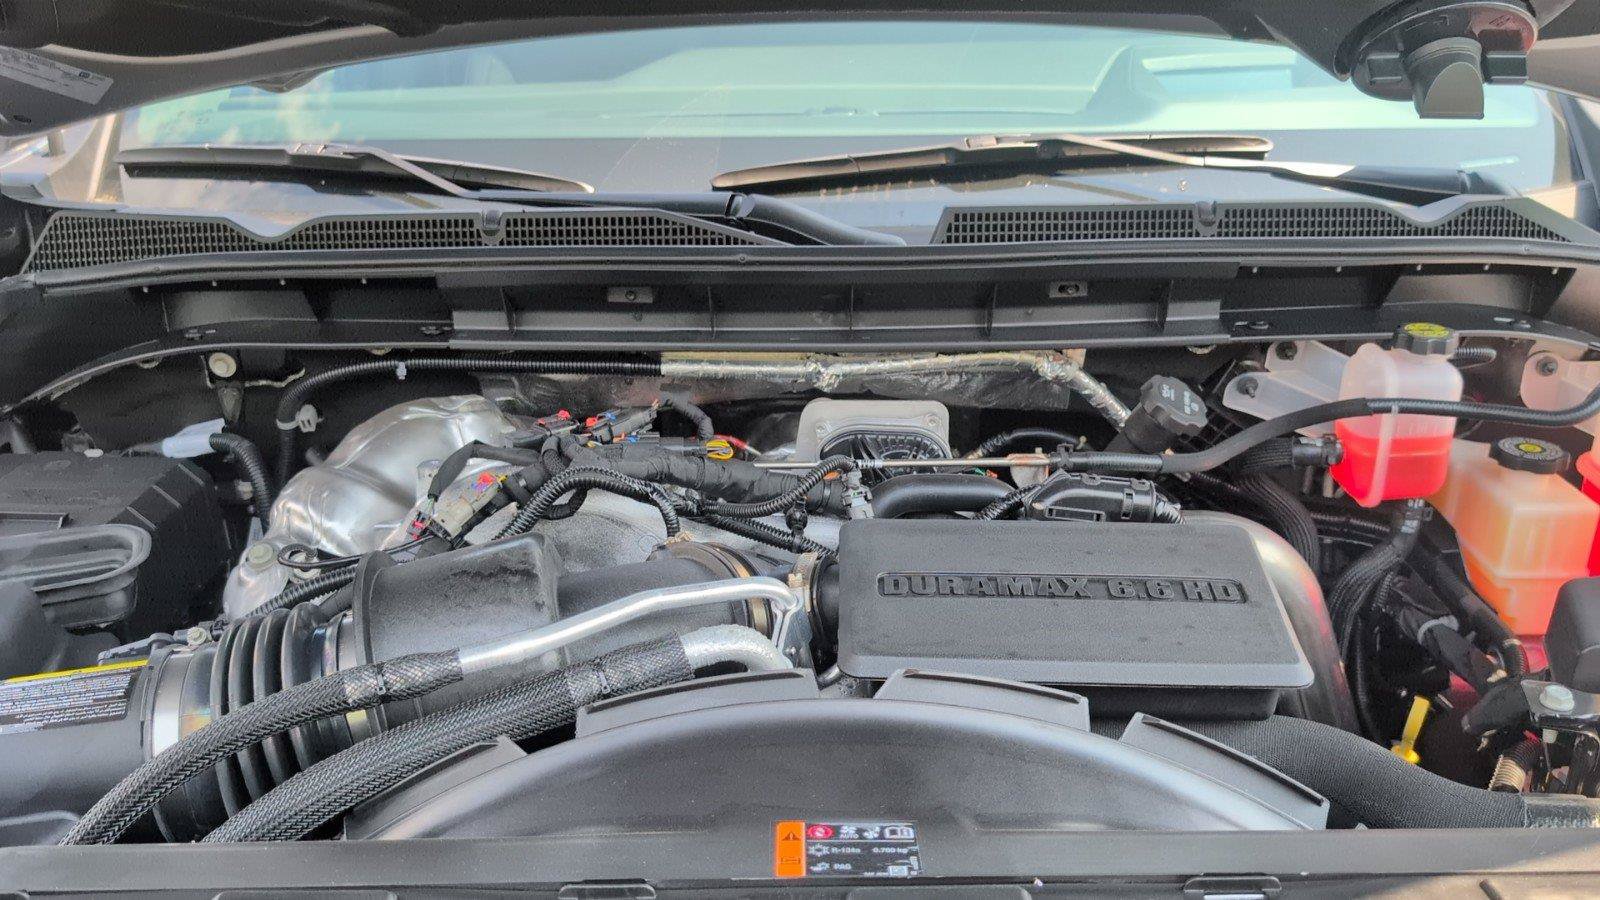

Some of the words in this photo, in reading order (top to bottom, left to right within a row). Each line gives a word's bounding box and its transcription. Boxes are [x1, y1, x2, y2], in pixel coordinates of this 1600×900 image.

[883, 574, 1091, 598] DURAMAX
[1107, 577, 1174, 601] 6.6
[1182, 578, 1243, 602] HD
